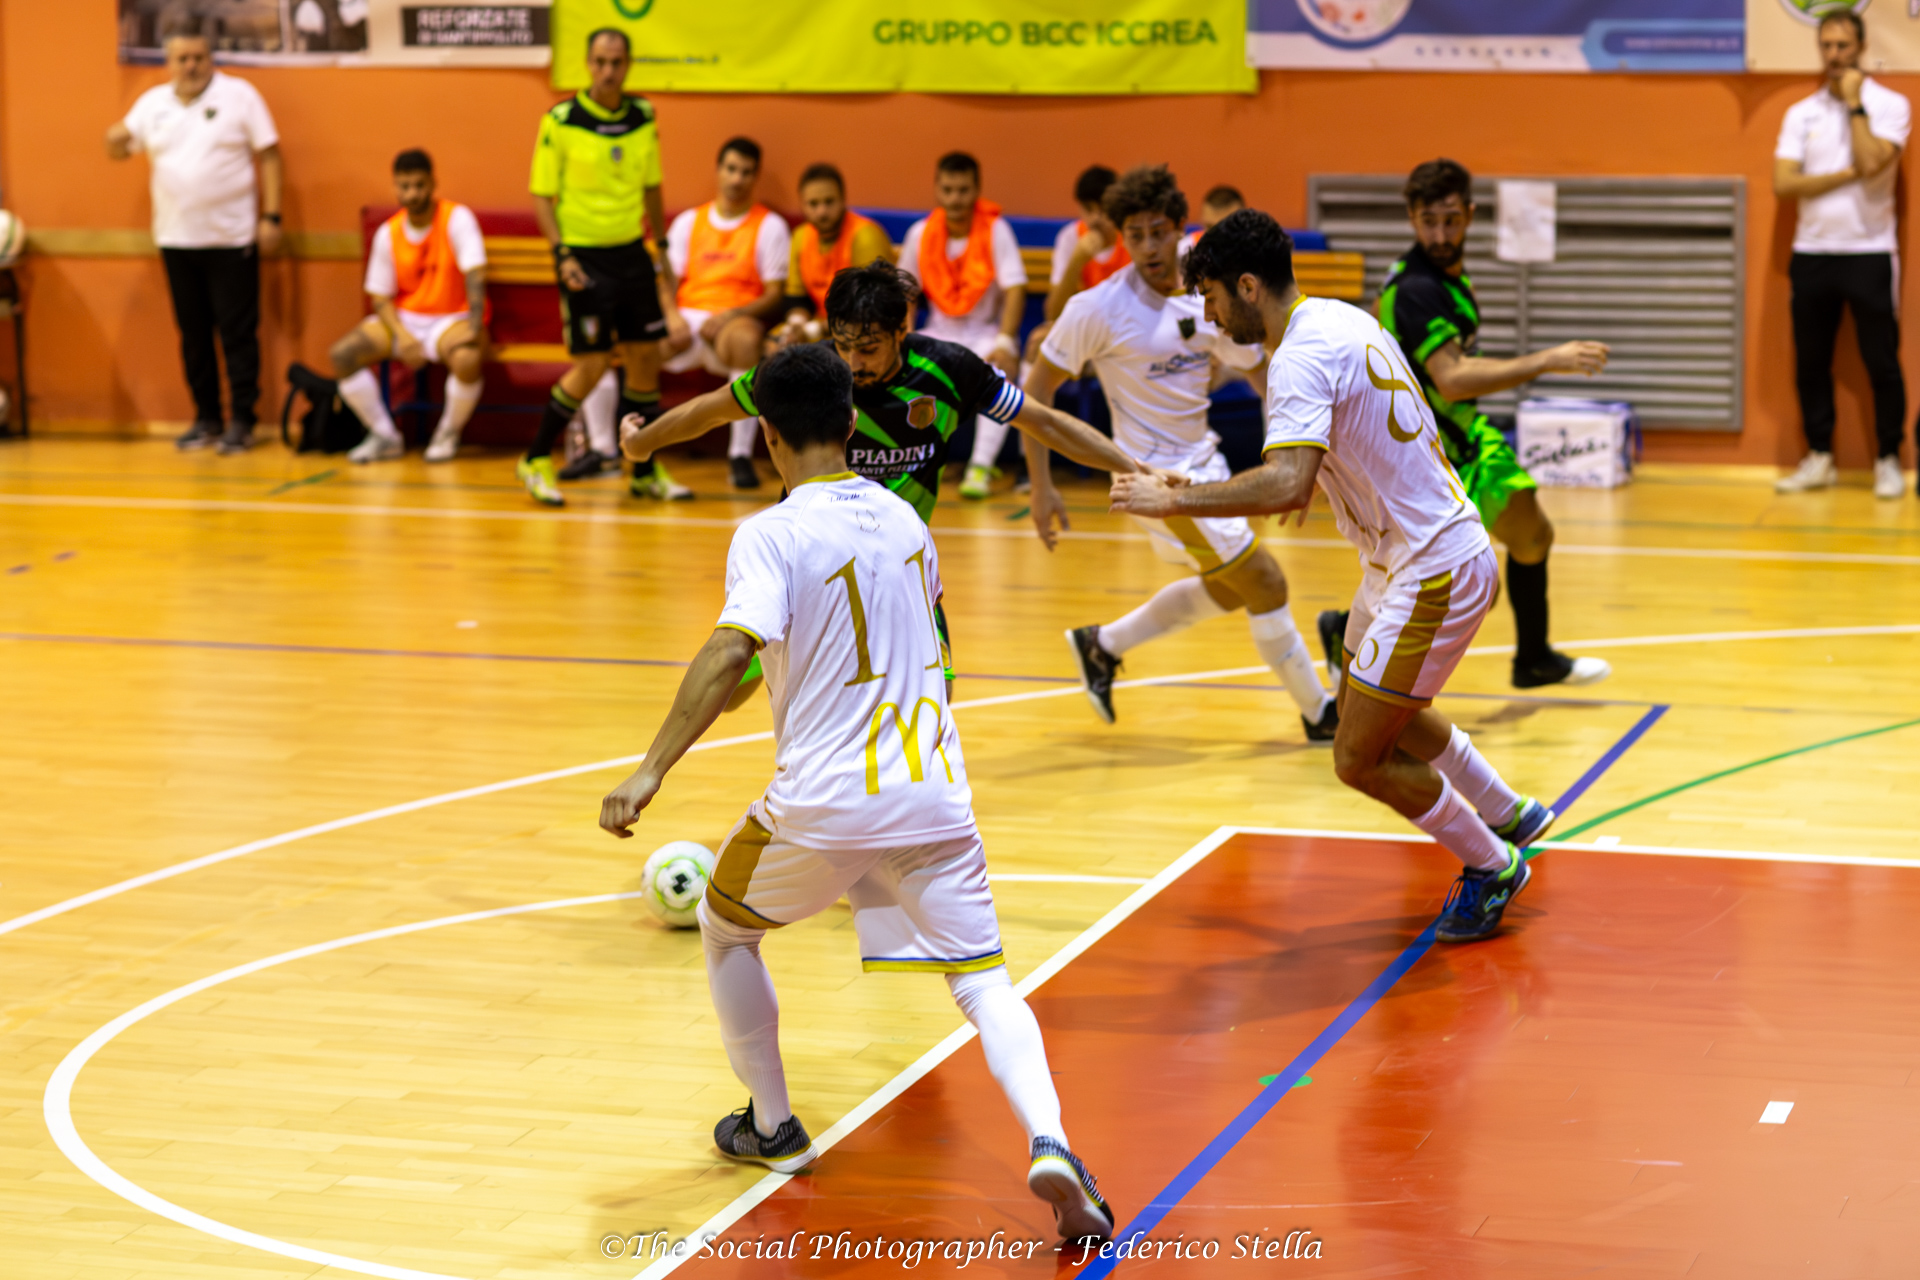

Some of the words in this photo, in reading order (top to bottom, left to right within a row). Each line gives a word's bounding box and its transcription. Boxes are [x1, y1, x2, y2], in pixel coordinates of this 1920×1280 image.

[873, 18, 1012, 46] GRUPPO
[1020, 20, 1088, 47] BCC
[1095, 18, 1219, 46] ICCREA
[824, 547, 943, 688] 11
